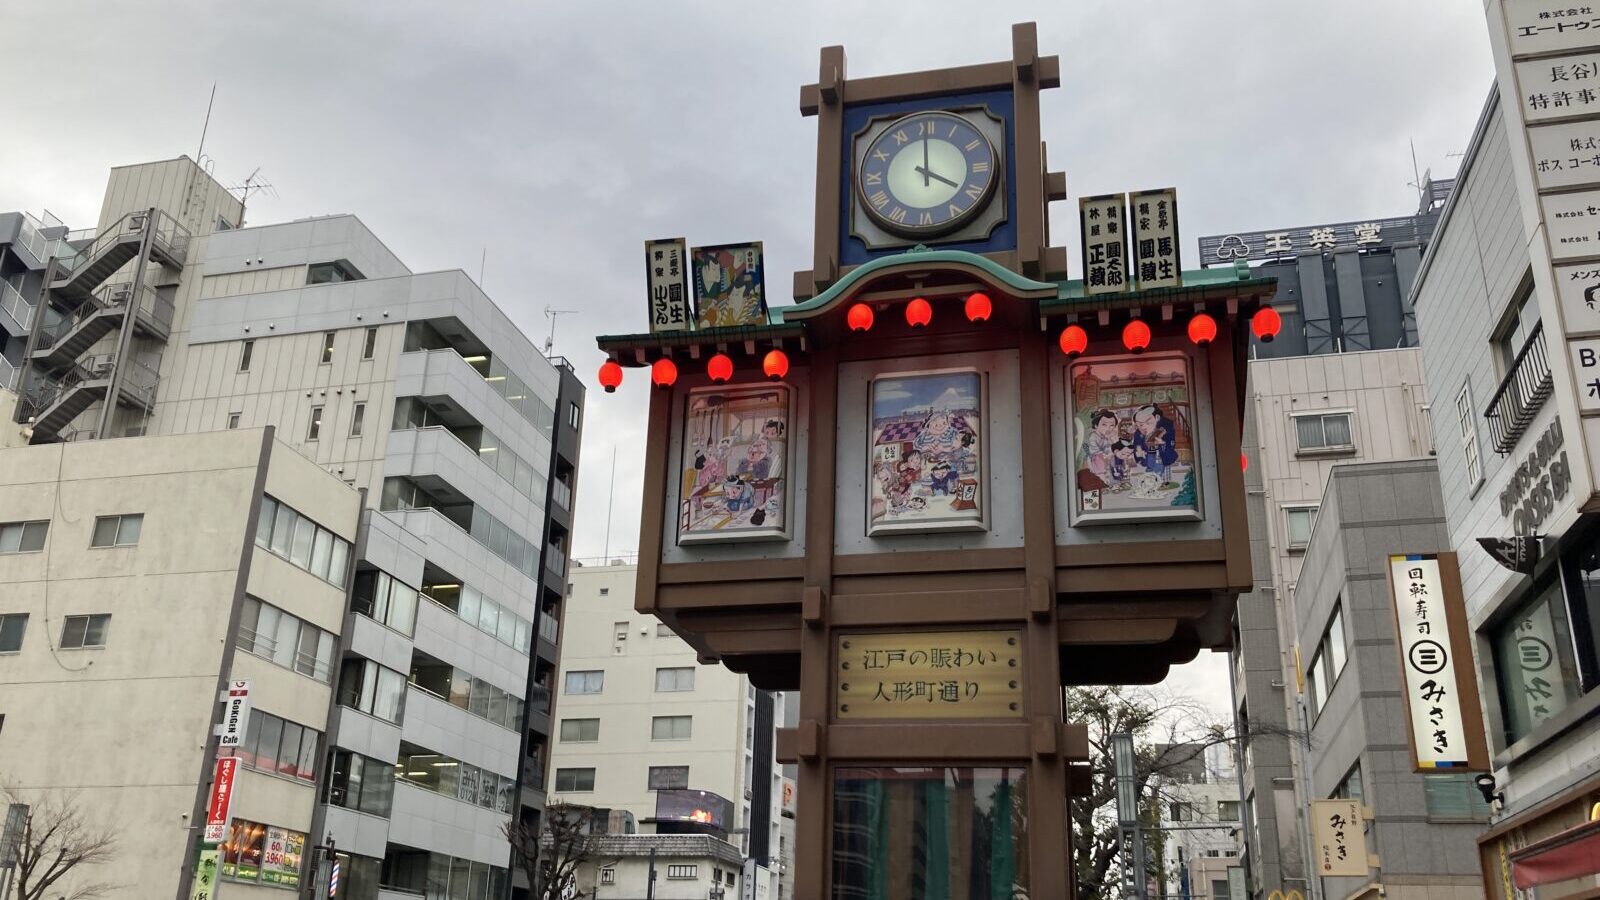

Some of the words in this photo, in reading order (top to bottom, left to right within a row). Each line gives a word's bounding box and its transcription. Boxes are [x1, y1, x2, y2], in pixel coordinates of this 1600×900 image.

[1538, 6, 1593, 19] 株式会社
[1528, 88, 1600, 110] 特許事
[1570, 136, 1600, 151] 株式
[1555, 211, 1584, 219] 株式会社
[1560, 236, 1589, 244] 株式会社
[1579, 348, 1600, 368] B
[1407, 566, 1432, 636] 回転寿司
[863, 648, 998, 670] 江戸の賑わい
[873, 680, 980, 704] 人形町通り
[1419, 678, 1449, 754] みさき
[1330, 814, 1347, 861] みさき
